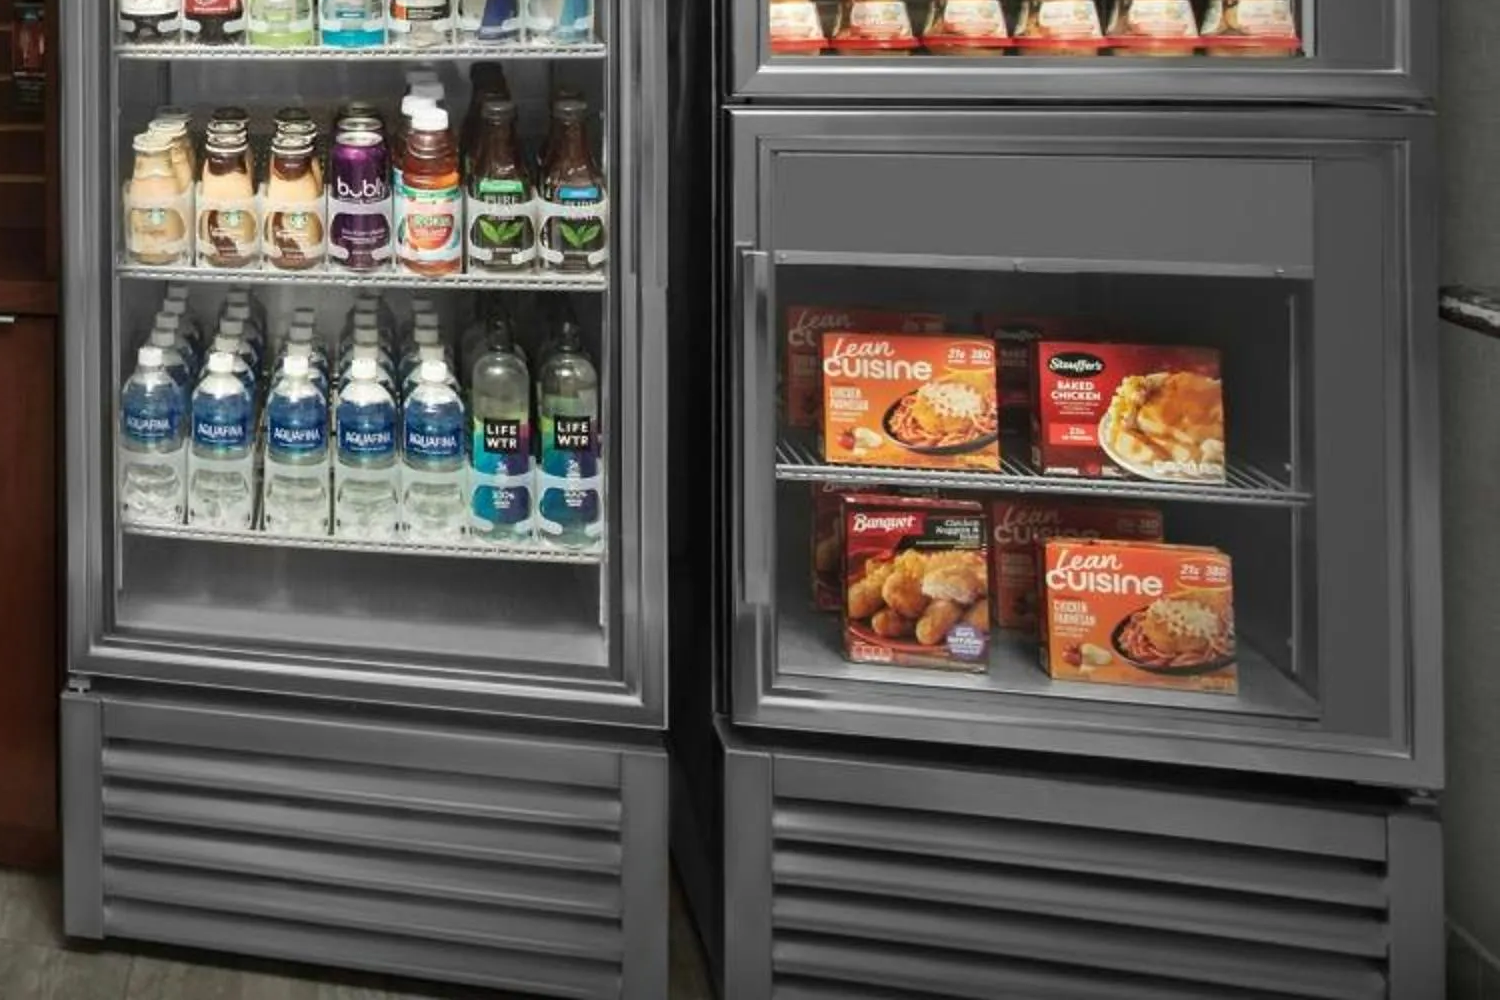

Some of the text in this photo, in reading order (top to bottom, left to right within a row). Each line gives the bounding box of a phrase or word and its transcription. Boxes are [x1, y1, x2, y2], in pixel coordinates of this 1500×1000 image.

[831, 337, 897, 360] Lean
[1057, 380, 1095, 391] BAKED
[1051, 391, 1101, 402] CHICKEN
[127, 417, 171, 431] AQUAFINA
[197, 423, 244, 439] AQUAFINA
[486, 424, 518, 436] LIFE
[557, 421, 589, 433] LIFE
[274, 428, 321, 442] AQUAFINA
[345, 431, 392, 447] AQUAFINA
[409, 433, 457, 449] AQUAFINA
[557, 434, 590, 447] WTR
[486, 437, 518, 450] WTR
[852, 513, 917, 533] Banquet
[1056, 549, 1124, 571] Lean
